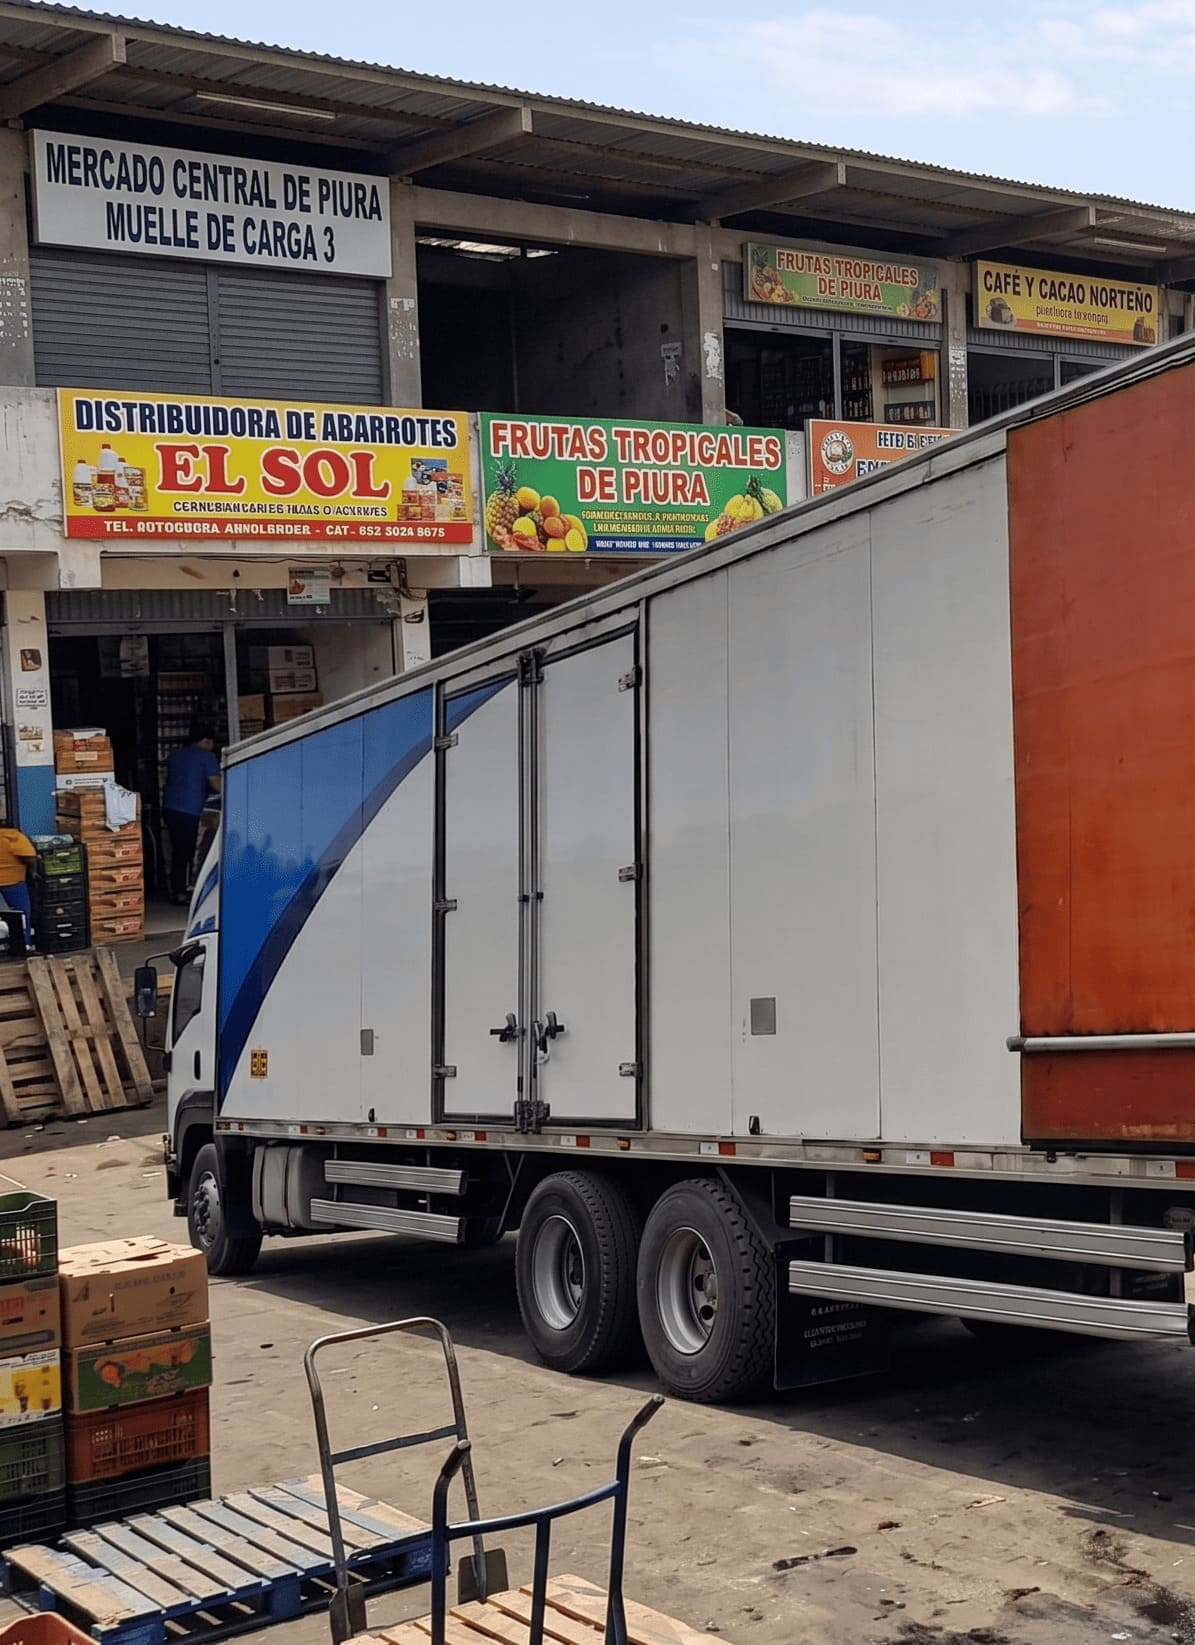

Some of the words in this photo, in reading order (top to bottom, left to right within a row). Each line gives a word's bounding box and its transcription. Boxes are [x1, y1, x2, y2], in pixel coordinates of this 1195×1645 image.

[46, 142, 165, 197] MERCADO
[172, 159, 277, 209] CENTRAL
[283, 173, 312, 213] DE
[319, 180, 382, 221] PIURA
[106, 202, 200, 249] MUELLE
[207, 212, 235, 253] DE
[243, 217, 317, 263] CARGA
[323, 226, 335, 263] 3
[777, 251, 831, 274] FRUTAS
[835, 259, 918, 287] TROPICALES
[818, 277, 836, 296] DE
[840, 280, 882, 301] PIURA
[984, 269, 1021, 297] CAFÉ
[1025, 276, 1036, 298] Y
[1039, 278, 1086, 304] CACAO
[1090, 286, 1153, 312] NORTEÑO
[75, 399, 281, 439] DISTRIBUIDORA
[287, 410, 317, 441] DE
[322, 416, 457, 447] ABARROTES
[491, 422, 607, 461] FRUTAS
[613, 429, 782, 468] TROPICALES
[155, 443, 245, 493] EL
[262, 448, 391, 498] SOL
[577, 468, 619, 502] DE
[624, 472, 709, 504] PIURA
[104, 520, 134, 532] TEL.
